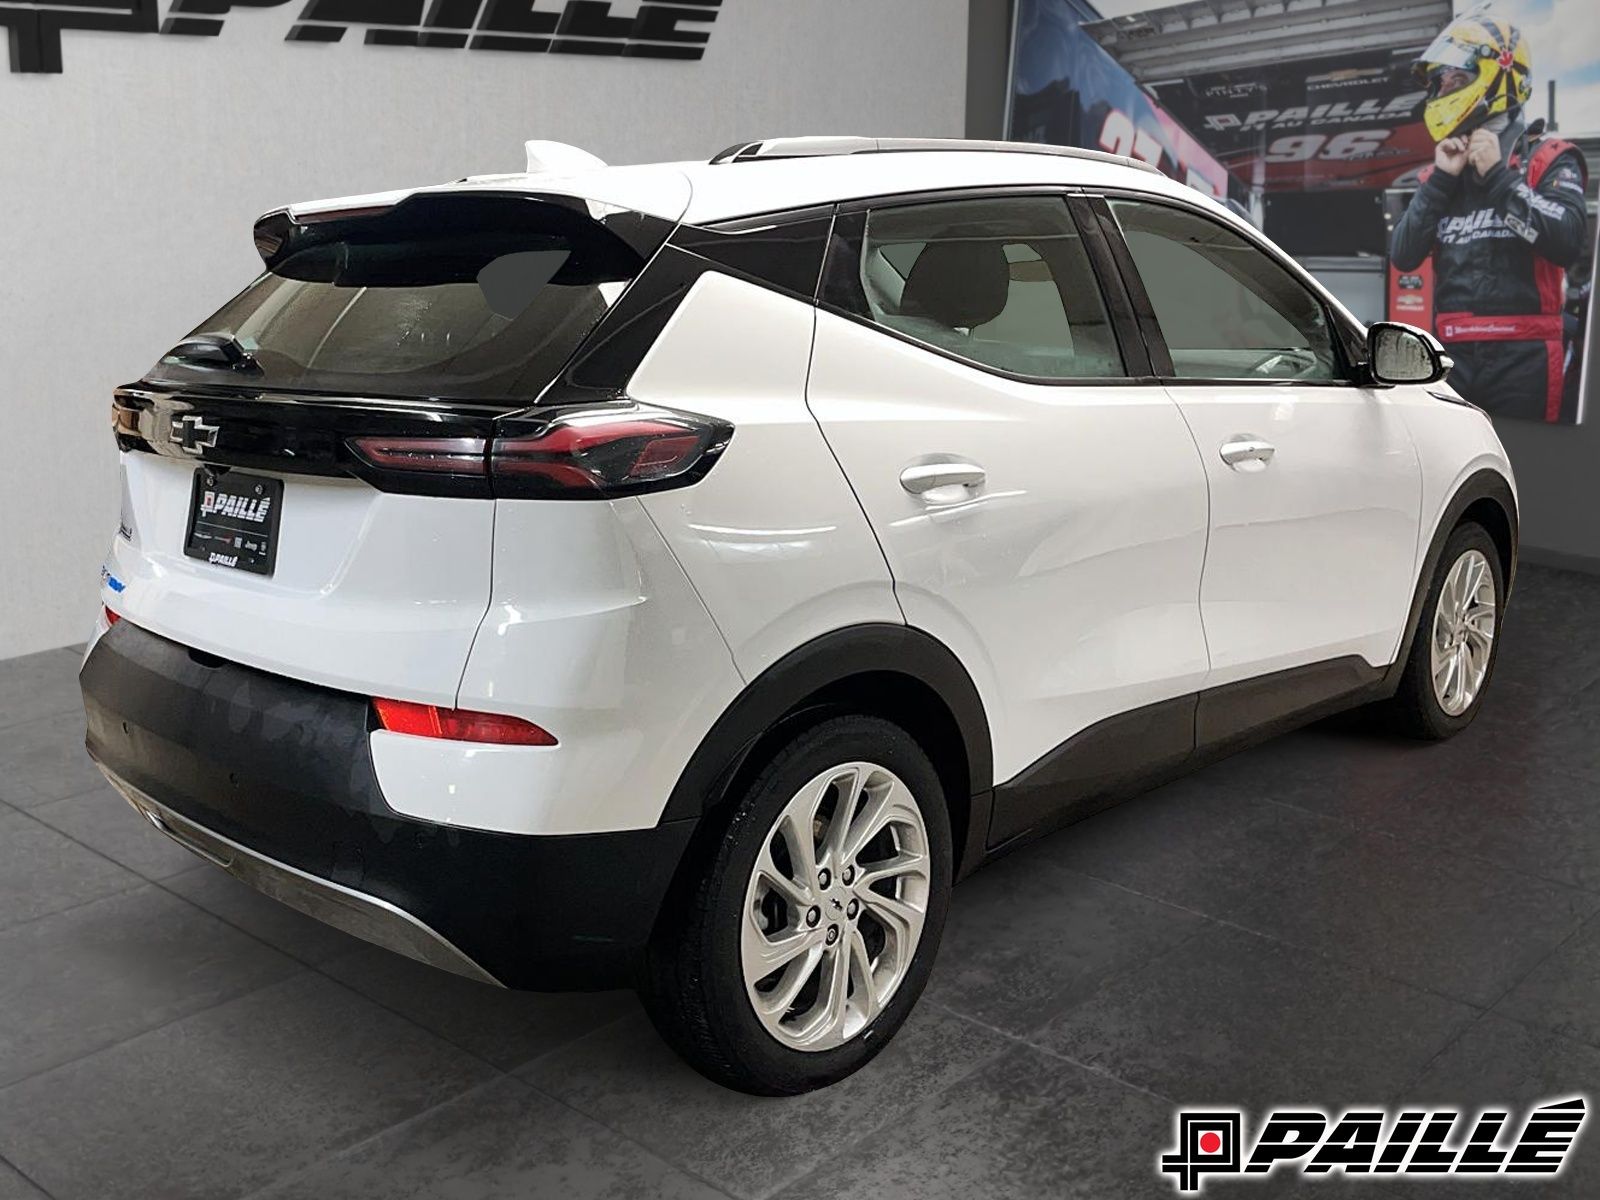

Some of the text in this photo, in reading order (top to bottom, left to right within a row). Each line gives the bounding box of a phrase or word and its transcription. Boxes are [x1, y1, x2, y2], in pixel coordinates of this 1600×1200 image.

[1306, 77, 1388, 91] CHEVROLET
[1272, 120, 1304, 129] AU
[1310, 111, 1412, 126] CANADA
[1264, 129, 1392, 163] 96
[214, 494, 271, 523] PAILLÉ
